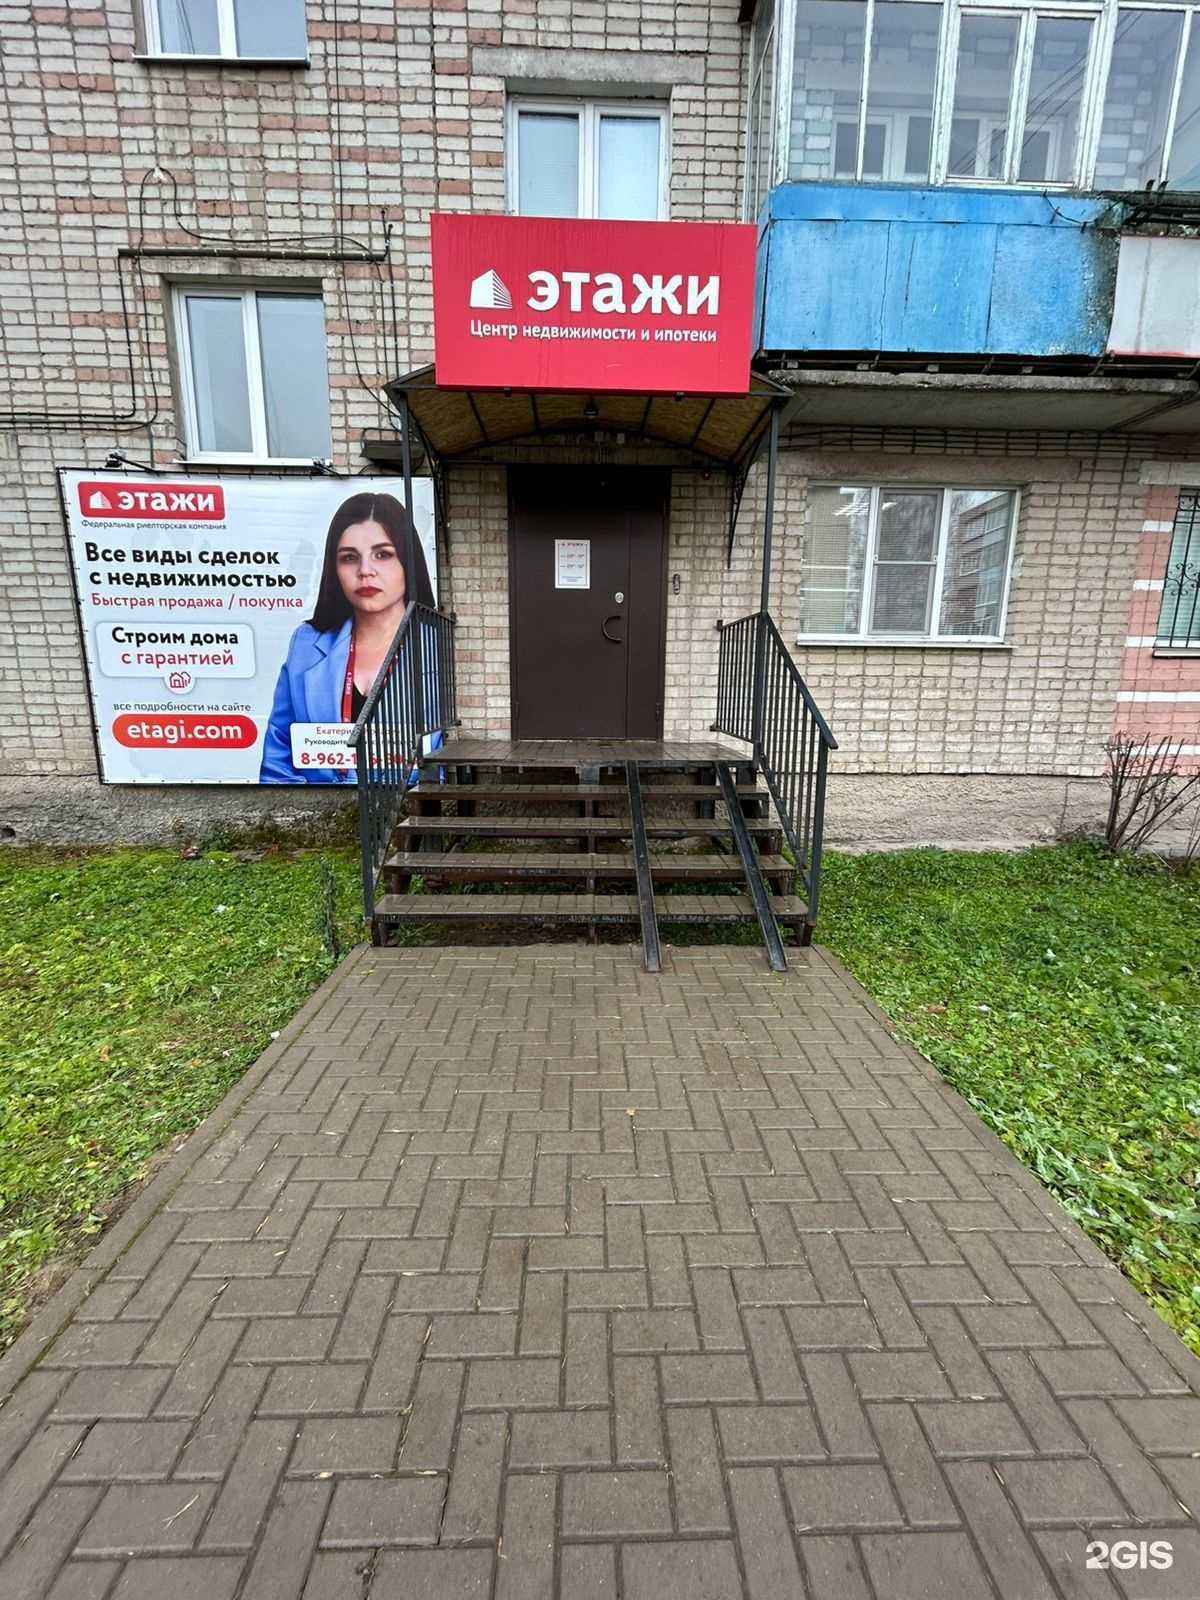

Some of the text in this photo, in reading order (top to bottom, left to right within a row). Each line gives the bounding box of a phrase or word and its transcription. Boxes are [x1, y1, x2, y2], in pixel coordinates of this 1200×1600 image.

[527, 270, 720, 315] этажи
[470, 319, 717, 342] Центр недвижимости и ипотеки
[81, 519, 135, 529] Федеральная
[136, 522, 187, 530] риелторская
[85, 542, 280, 566] Все виды сделок
[89, 572, 297, 588] с недвижимостью
[91, 593, 304, 611] Быстрая продажа / покупка
[112, 627, 239, 647] Строим дома
[121, 650, 234, 668] с гарантией
[113, 703, 132, 711] все
[134, 701, 205, 712] подробности
[221, 702, 252, 711] сайте
[127, 719, 242, 744] etagi.com
[316, 726, 353, 736] Екатери
